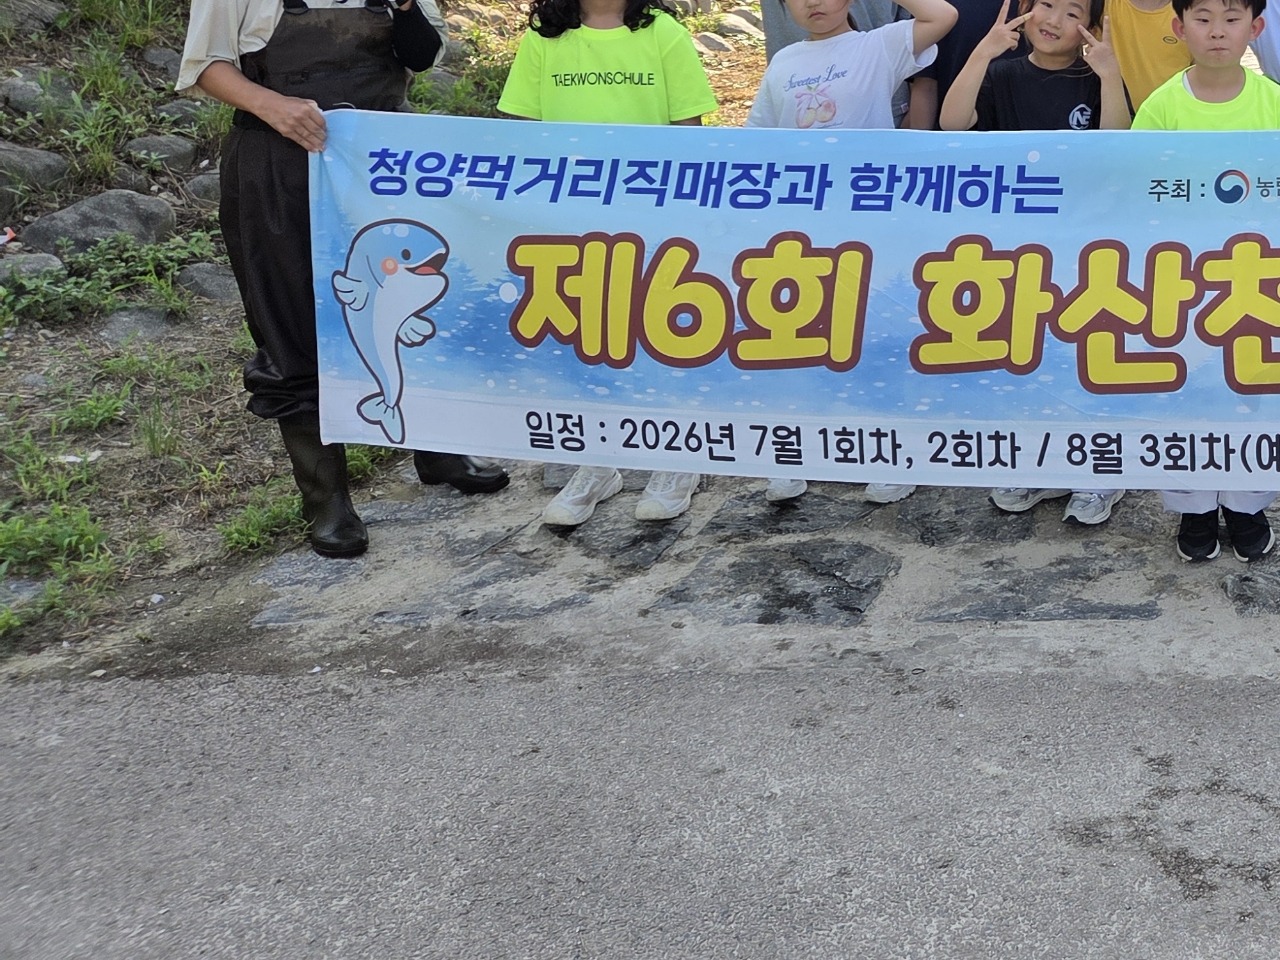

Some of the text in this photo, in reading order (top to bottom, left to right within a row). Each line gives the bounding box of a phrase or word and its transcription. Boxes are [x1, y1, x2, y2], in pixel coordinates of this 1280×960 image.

[552, 71, 655, 86] TAEKWONSCHULE
[367, 148, 1064, 213] 청양먹거리직매장과 함께하는
[1148, 178, 1191, 202] 주최
[508, 231, 873, 373] 제6회
[525, 411, 586, 452] 일정
[619, 418, 736, 463] 2026년
[749, 424, 803, 466] 7월
[818, 426, 914, 469] 1회차,
[928, 429, 1021, 470] 2회차
[1066, 432, 1124, 475] 8월
